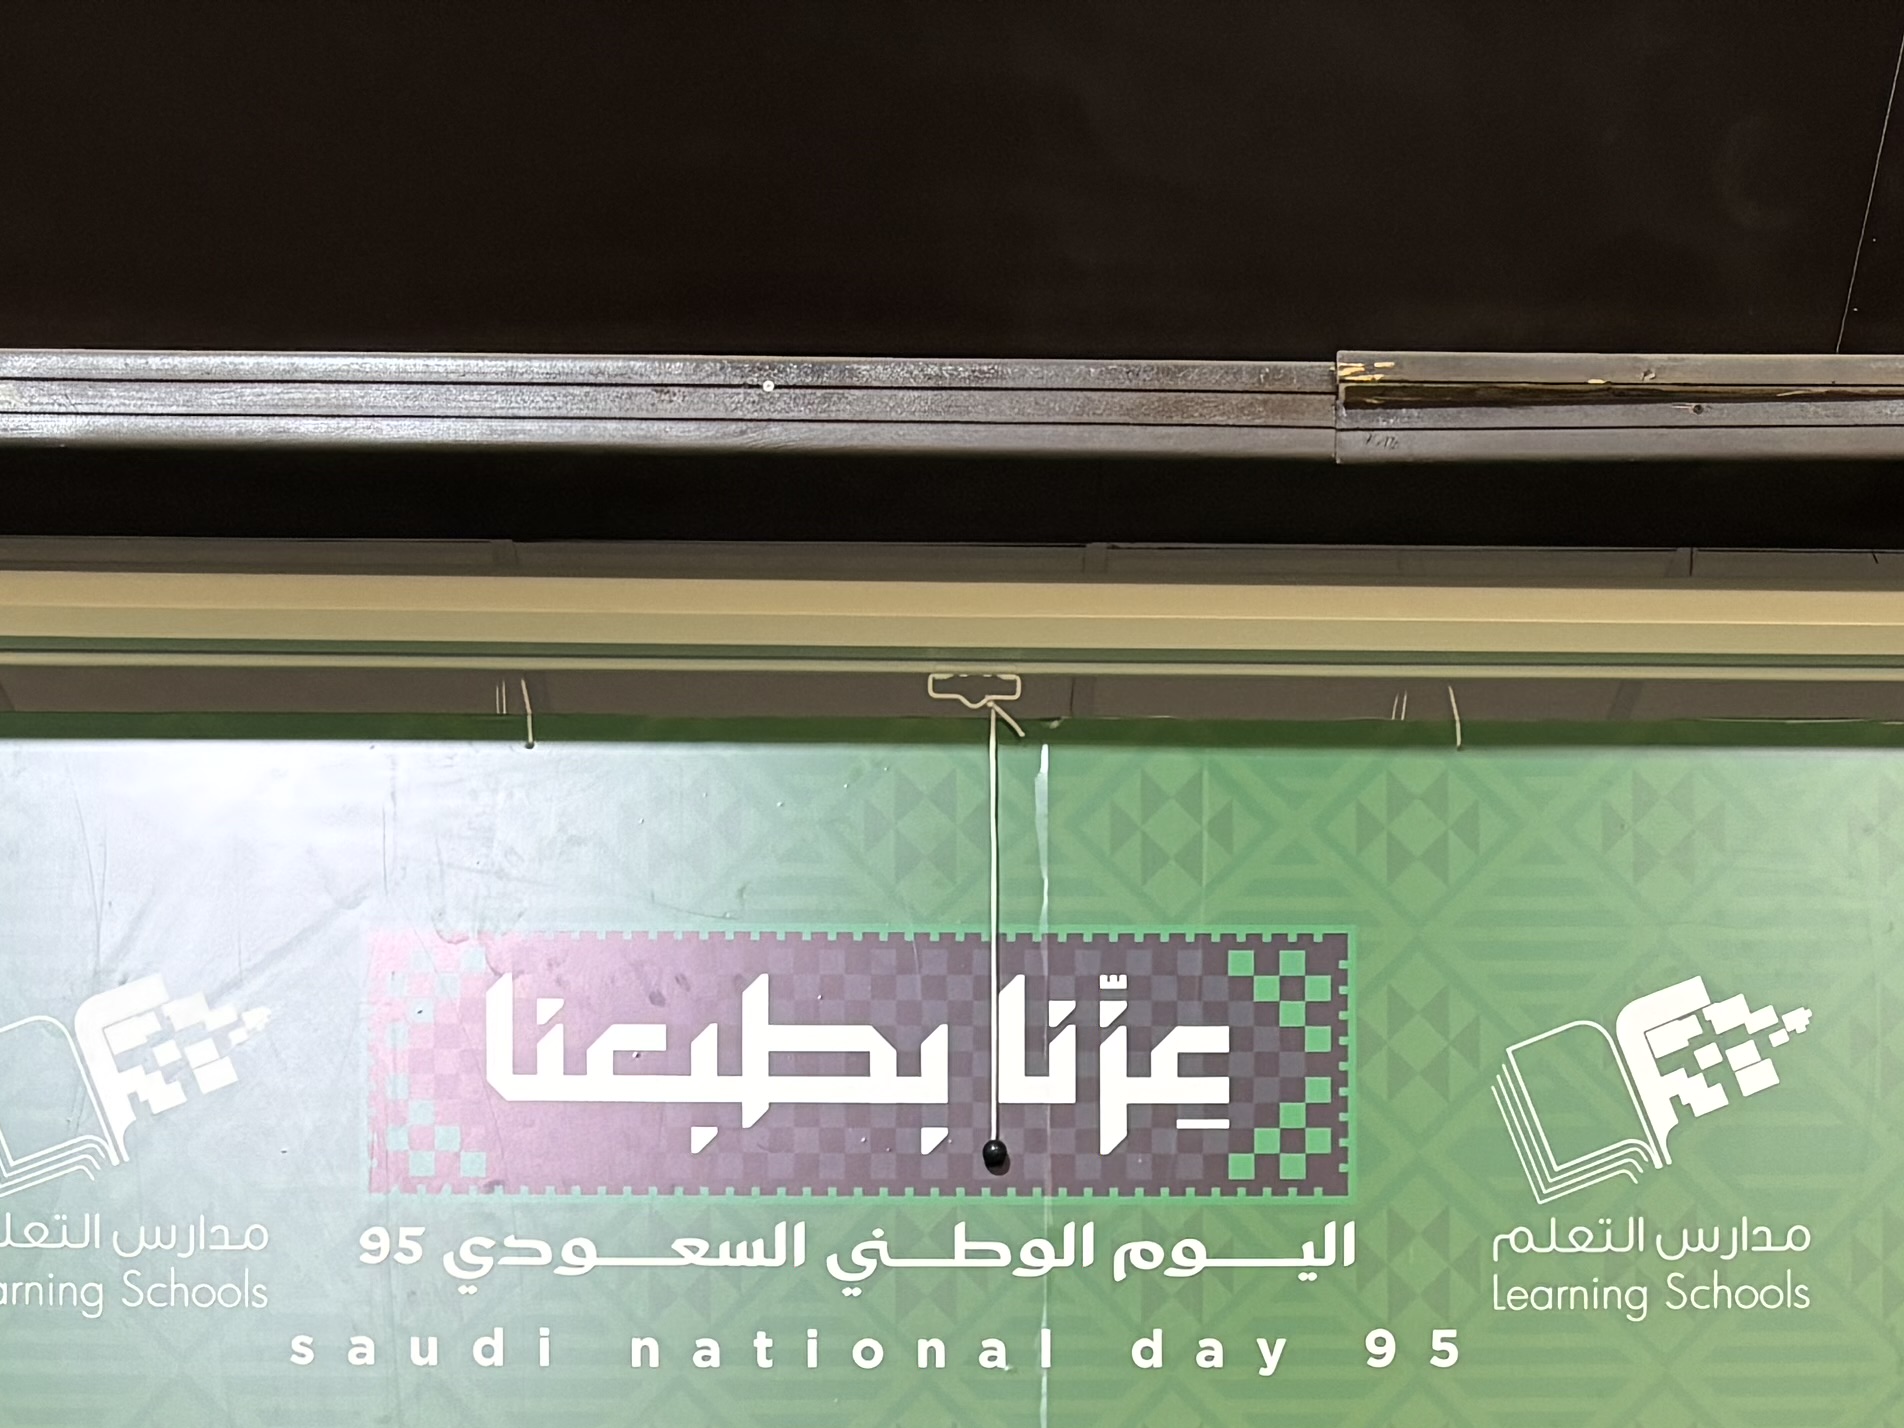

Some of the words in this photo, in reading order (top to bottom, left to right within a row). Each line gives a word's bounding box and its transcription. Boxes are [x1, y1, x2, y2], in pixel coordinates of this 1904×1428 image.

[486, 972, 948, 1154] بطبعنا
[114, 1216, 269, 1258] مدارس
[358, 1226, 426, 1266] 95
[443, 1220, 806, 1295] السعودي
[825, 1220, 1095, 1296] الوطني
[1111, 1220, 1356, 1282] اليوم
[1491, 1215, 1643, 1261] التعلم
[1657, 1217, 1812, 1261] مدارس
[121, 1269, 270, 1309] Schools
[1491, 1273, 1649, 1322] Learning
[1664, 1268, 1812, 1311] Schools
[289, 1325, 554, 1370] saudi
[629, 1326, 1053, 1371] national
[1130, 1329, 1290, 1377] day
[1364, 1329, 1462, 1369] 95
